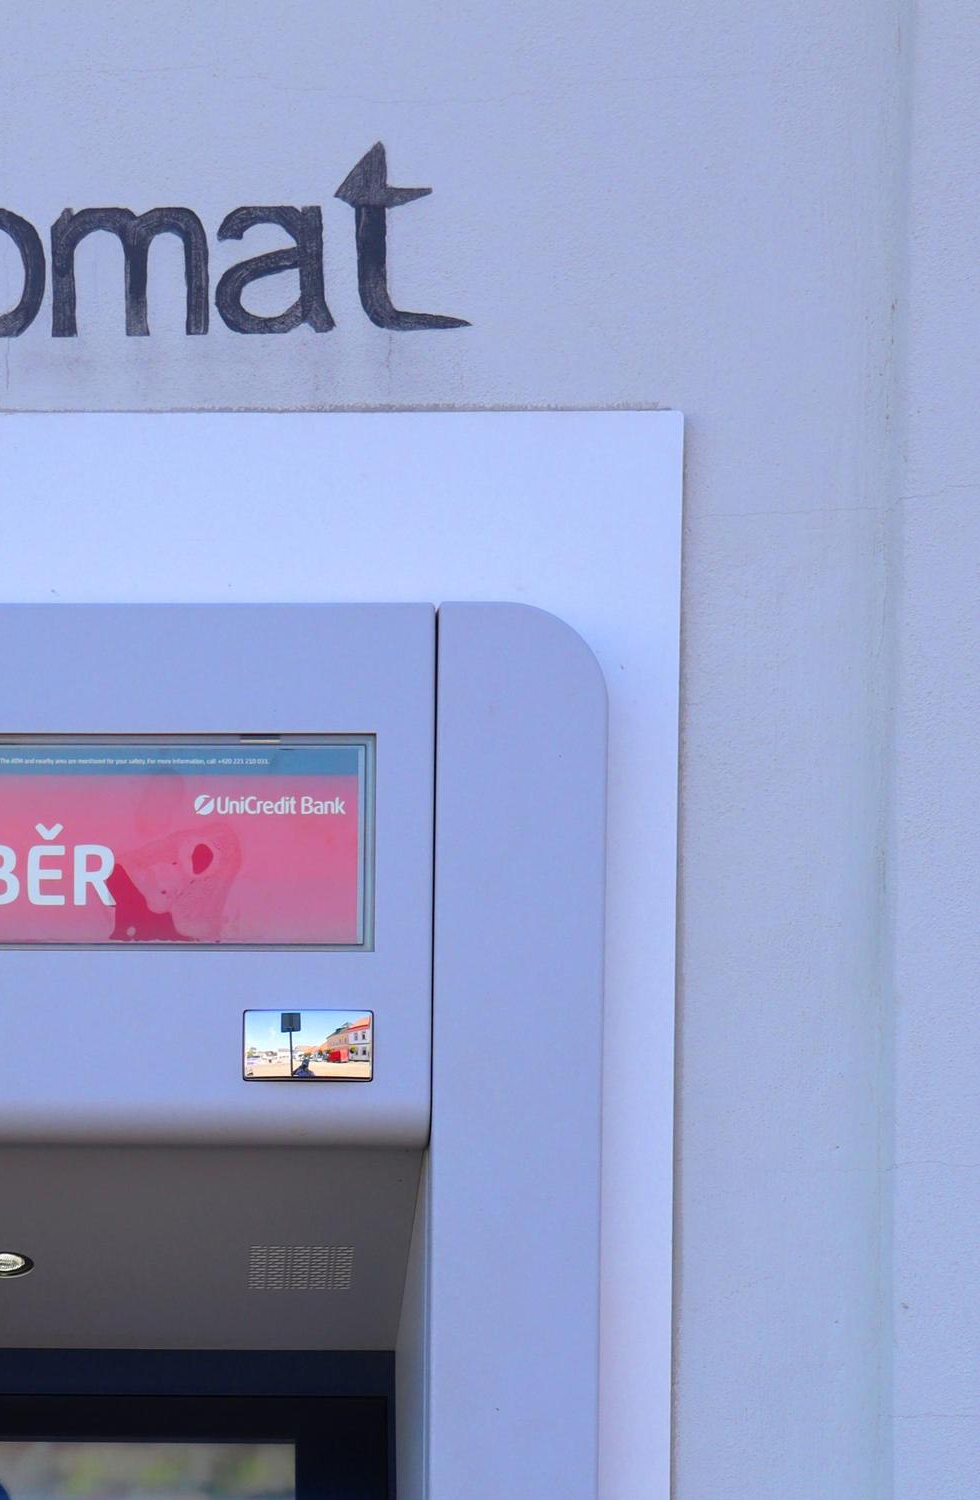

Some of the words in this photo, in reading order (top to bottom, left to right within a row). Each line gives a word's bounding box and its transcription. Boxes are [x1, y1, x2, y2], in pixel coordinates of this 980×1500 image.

[24, 757, 35, 765] and
[35, 757, 54, 765] nearby
[55, 757, 67, 765] area
[67, 757, 76, 765] are
[78, 757, 105, 765] monitored
[115, 757, 127, 765] your
[147, 757, 156, 765] For
[157, 757, 171, 765] more
[233, 757, 244, 765] 221
[245, 757, 256, 765] 210
[216, 796, 296, 815] UniCredit
[300, 796, 345, 815] Bank
